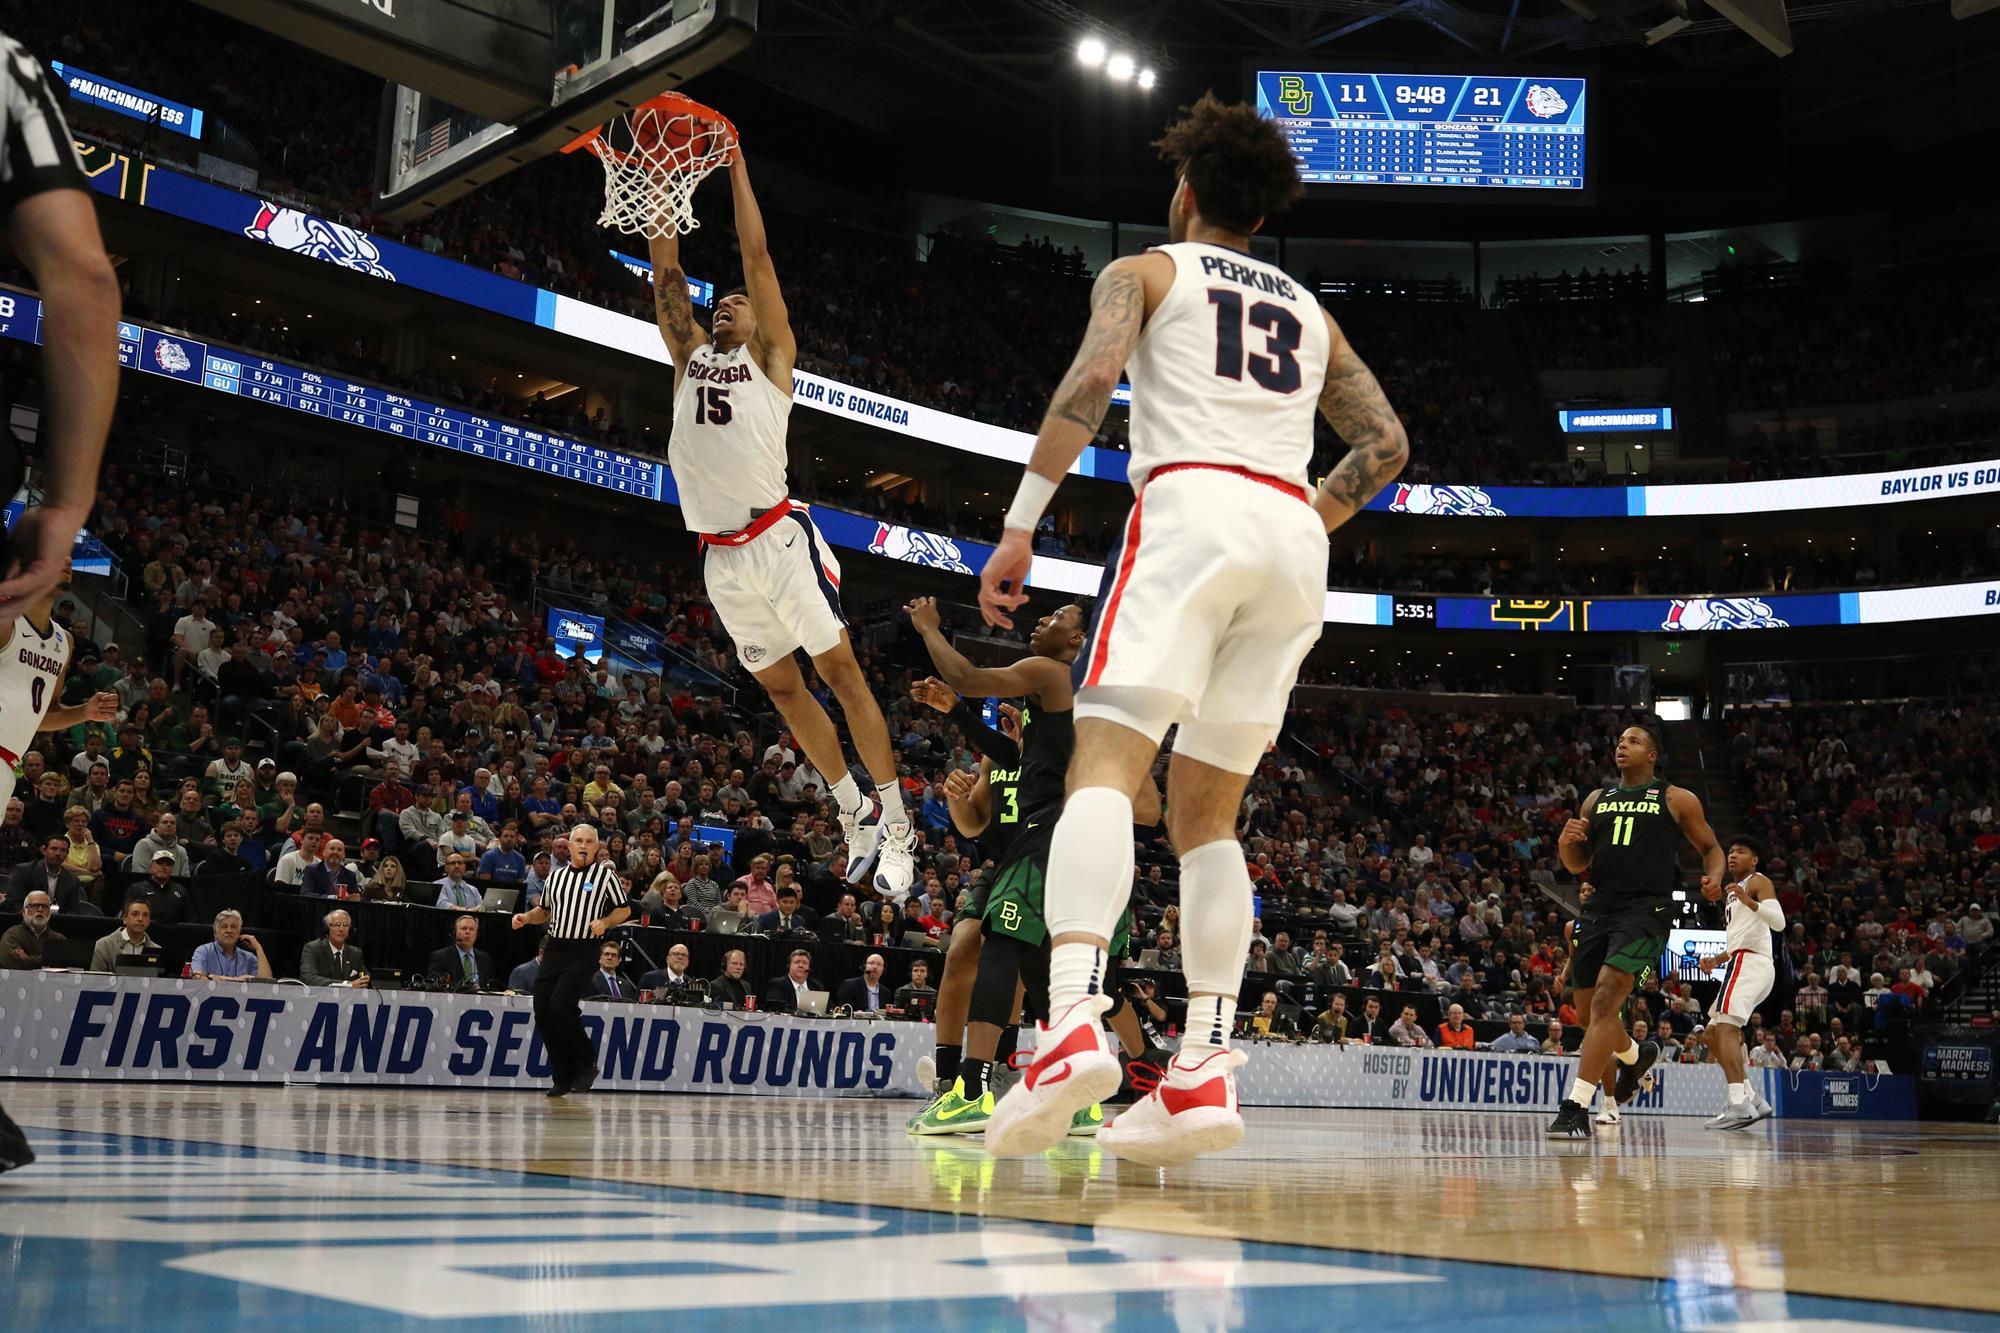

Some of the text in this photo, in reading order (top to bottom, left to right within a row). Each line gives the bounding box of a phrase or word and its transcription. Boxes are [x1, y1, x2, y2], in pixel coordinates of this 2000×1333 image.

[1279, 76, 1501, 115] BU 11 9:48 21
[1200, 256, 1297, 301] PERKINS
[1206, 288, 1303, 394] 13
[688, 360, 752, 384] GONZAGA
[212, 361, 236, 374] BAY
[301, 384, 322, 396] 35.7
[392, 407, 404, 417] 20
[476, 429, 483, 437] 0
[506, 437, 513, 446] 3
[530, 443, 536, 452] 5
[553, 449, 559, 457] 7
[576, 456, 581, 464] 1
[597, 461, 604, 469] 0
[620, 467, 625, 475] 1
[641, 472, 647, 480] 5
[262, 361, 274, 371] FG
[303, 373, 322, 384] FG%
[347, 384, 365, 394] 3PT
[386, 394, 412, 407] 3PT%
[435, 407, 446, 415] FT
[472, 417, 489, 428] FT%
[548, 437, 564, 447] REB
[571, 444, 587, 453] AST
[594, 449, 609, 459] STL
[638, 461, 652, 470] TOV
[696, 386, 732, 425] 15
[828, 388, 845, 407] VS
[848, 396, 908, 426] GONZAGA
[1572, 414, 1657, 426] #MARCHMADNESS
[213, 378, 230, 390] GU
[300, 400, 320, 413] 57.1
[390, 422, 403, 433] 40
[472, 444, 484, 454] 75
[506, 452, 512, 460] 2
[528, 458, 535, 466] 6
[552, 464, 558, 472] 8
[574, 470, 580, 478] 5
[597, 476, 603, 484] 2
[619, 481, 625, 489] 2
[641, 487, 646, 495] 1
[1881, 468, 2000, 495] BAYLOR VS GO
[1396, 604, 1424, 618] 5:35
[1985, 590, 2000, 606] B
[32, 676, 46, 714] 0
[1000, 788, 1019, 823] 3
[1596, 801, 1660, 815] BAYLOR
[1612, 816, 1634, 846] 11
[1000, 900, 1022, 931] BU
[60, 990, 286, 1070] FIRST
[293, 1002, 433, 1073] AND
[693, 1022, 896, 1089] ROUNDS
[1937, 1049, 1972, 1060] MARCH
[1363, 1054, 1411, 1075] HOSTED
[1941, 1060, 1990, 1071] MADNESS
[1392, 1079, 1409, 1099] BY
[1420, 1056, 1570, 1104] UNIVERSITY
[1829, 1081, 1849, 1093] MARCH
[1833, 1094, 1858, 1107] MADNESS
